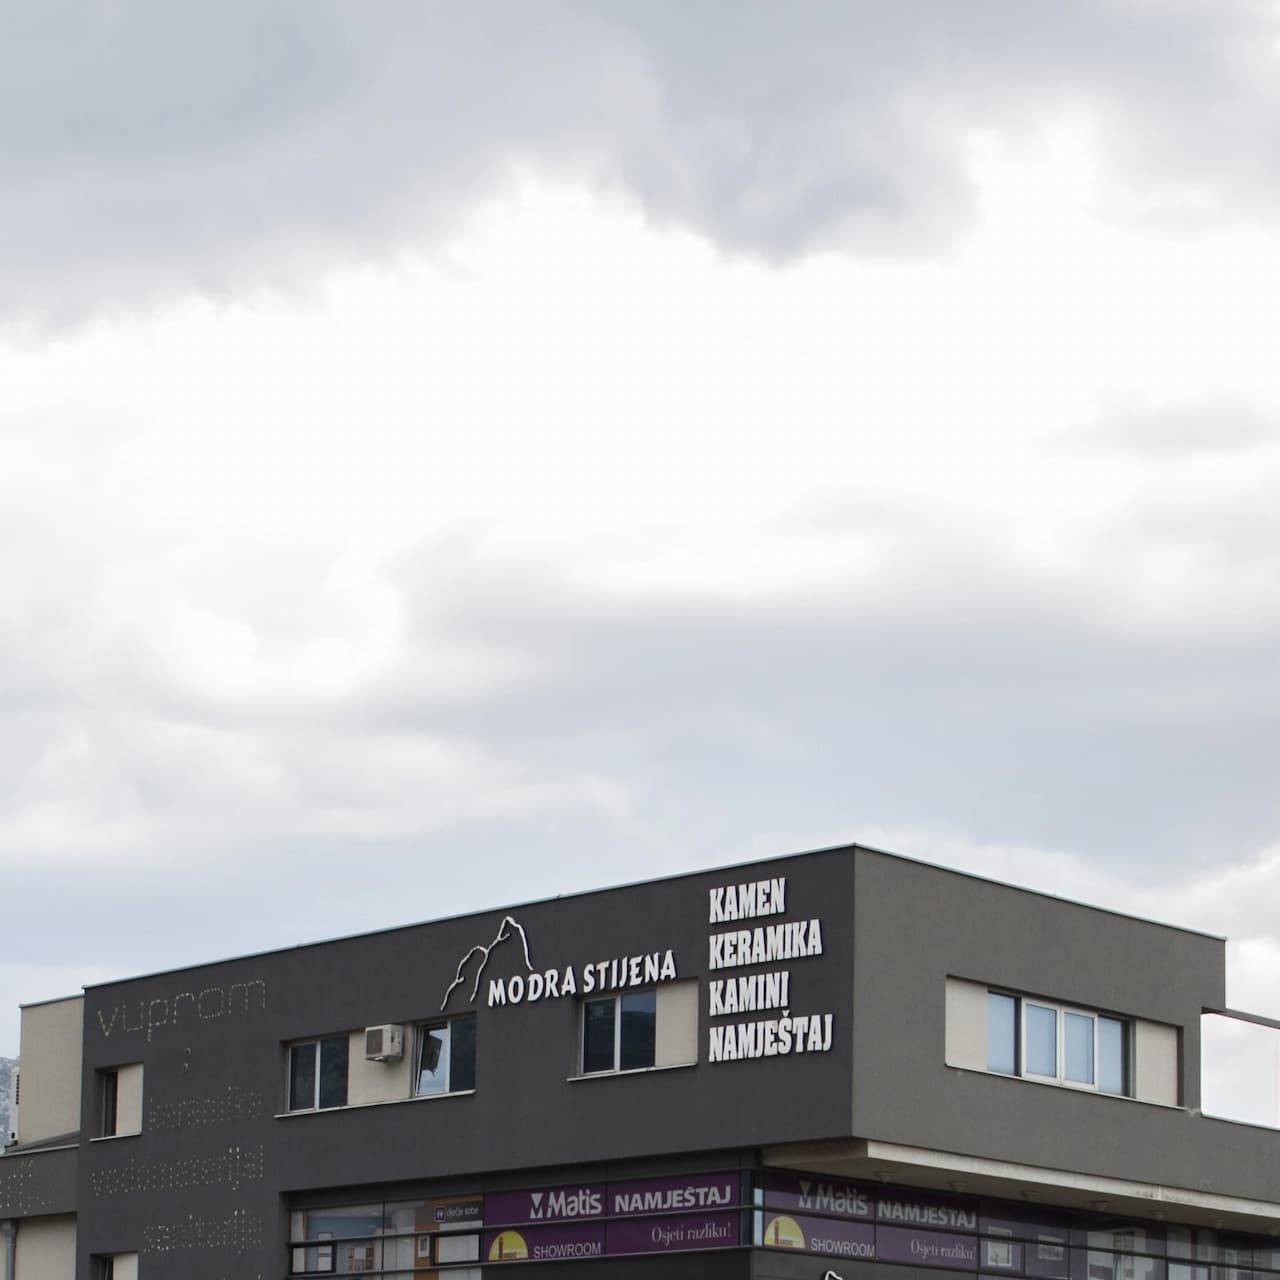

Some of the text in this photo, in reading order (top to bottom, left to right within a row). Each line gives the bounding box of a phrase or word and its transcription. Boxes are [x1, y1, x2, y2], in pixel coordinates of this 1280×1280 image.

[709, 877, 785, 924] KAMEN
[709, 919, 822, 970] KERAMIKA
[487, 949, 677, 1008] MODRA STIJENA
[709, 971, 789, 1017] KAMINI
[708, 1010, 833, 1062] NAMJEŠTAJ
[547, 1185, 731, 1218] Matis NAMJEŠTAJ
[816, 1183, 869, 1216] Matis
[533, 1242, 601, 1259] SHOWROOM
[651, 1222, 731, 1246] Osjeti razliku!
[811, 1238, 875, 1258] SHOWROOM
